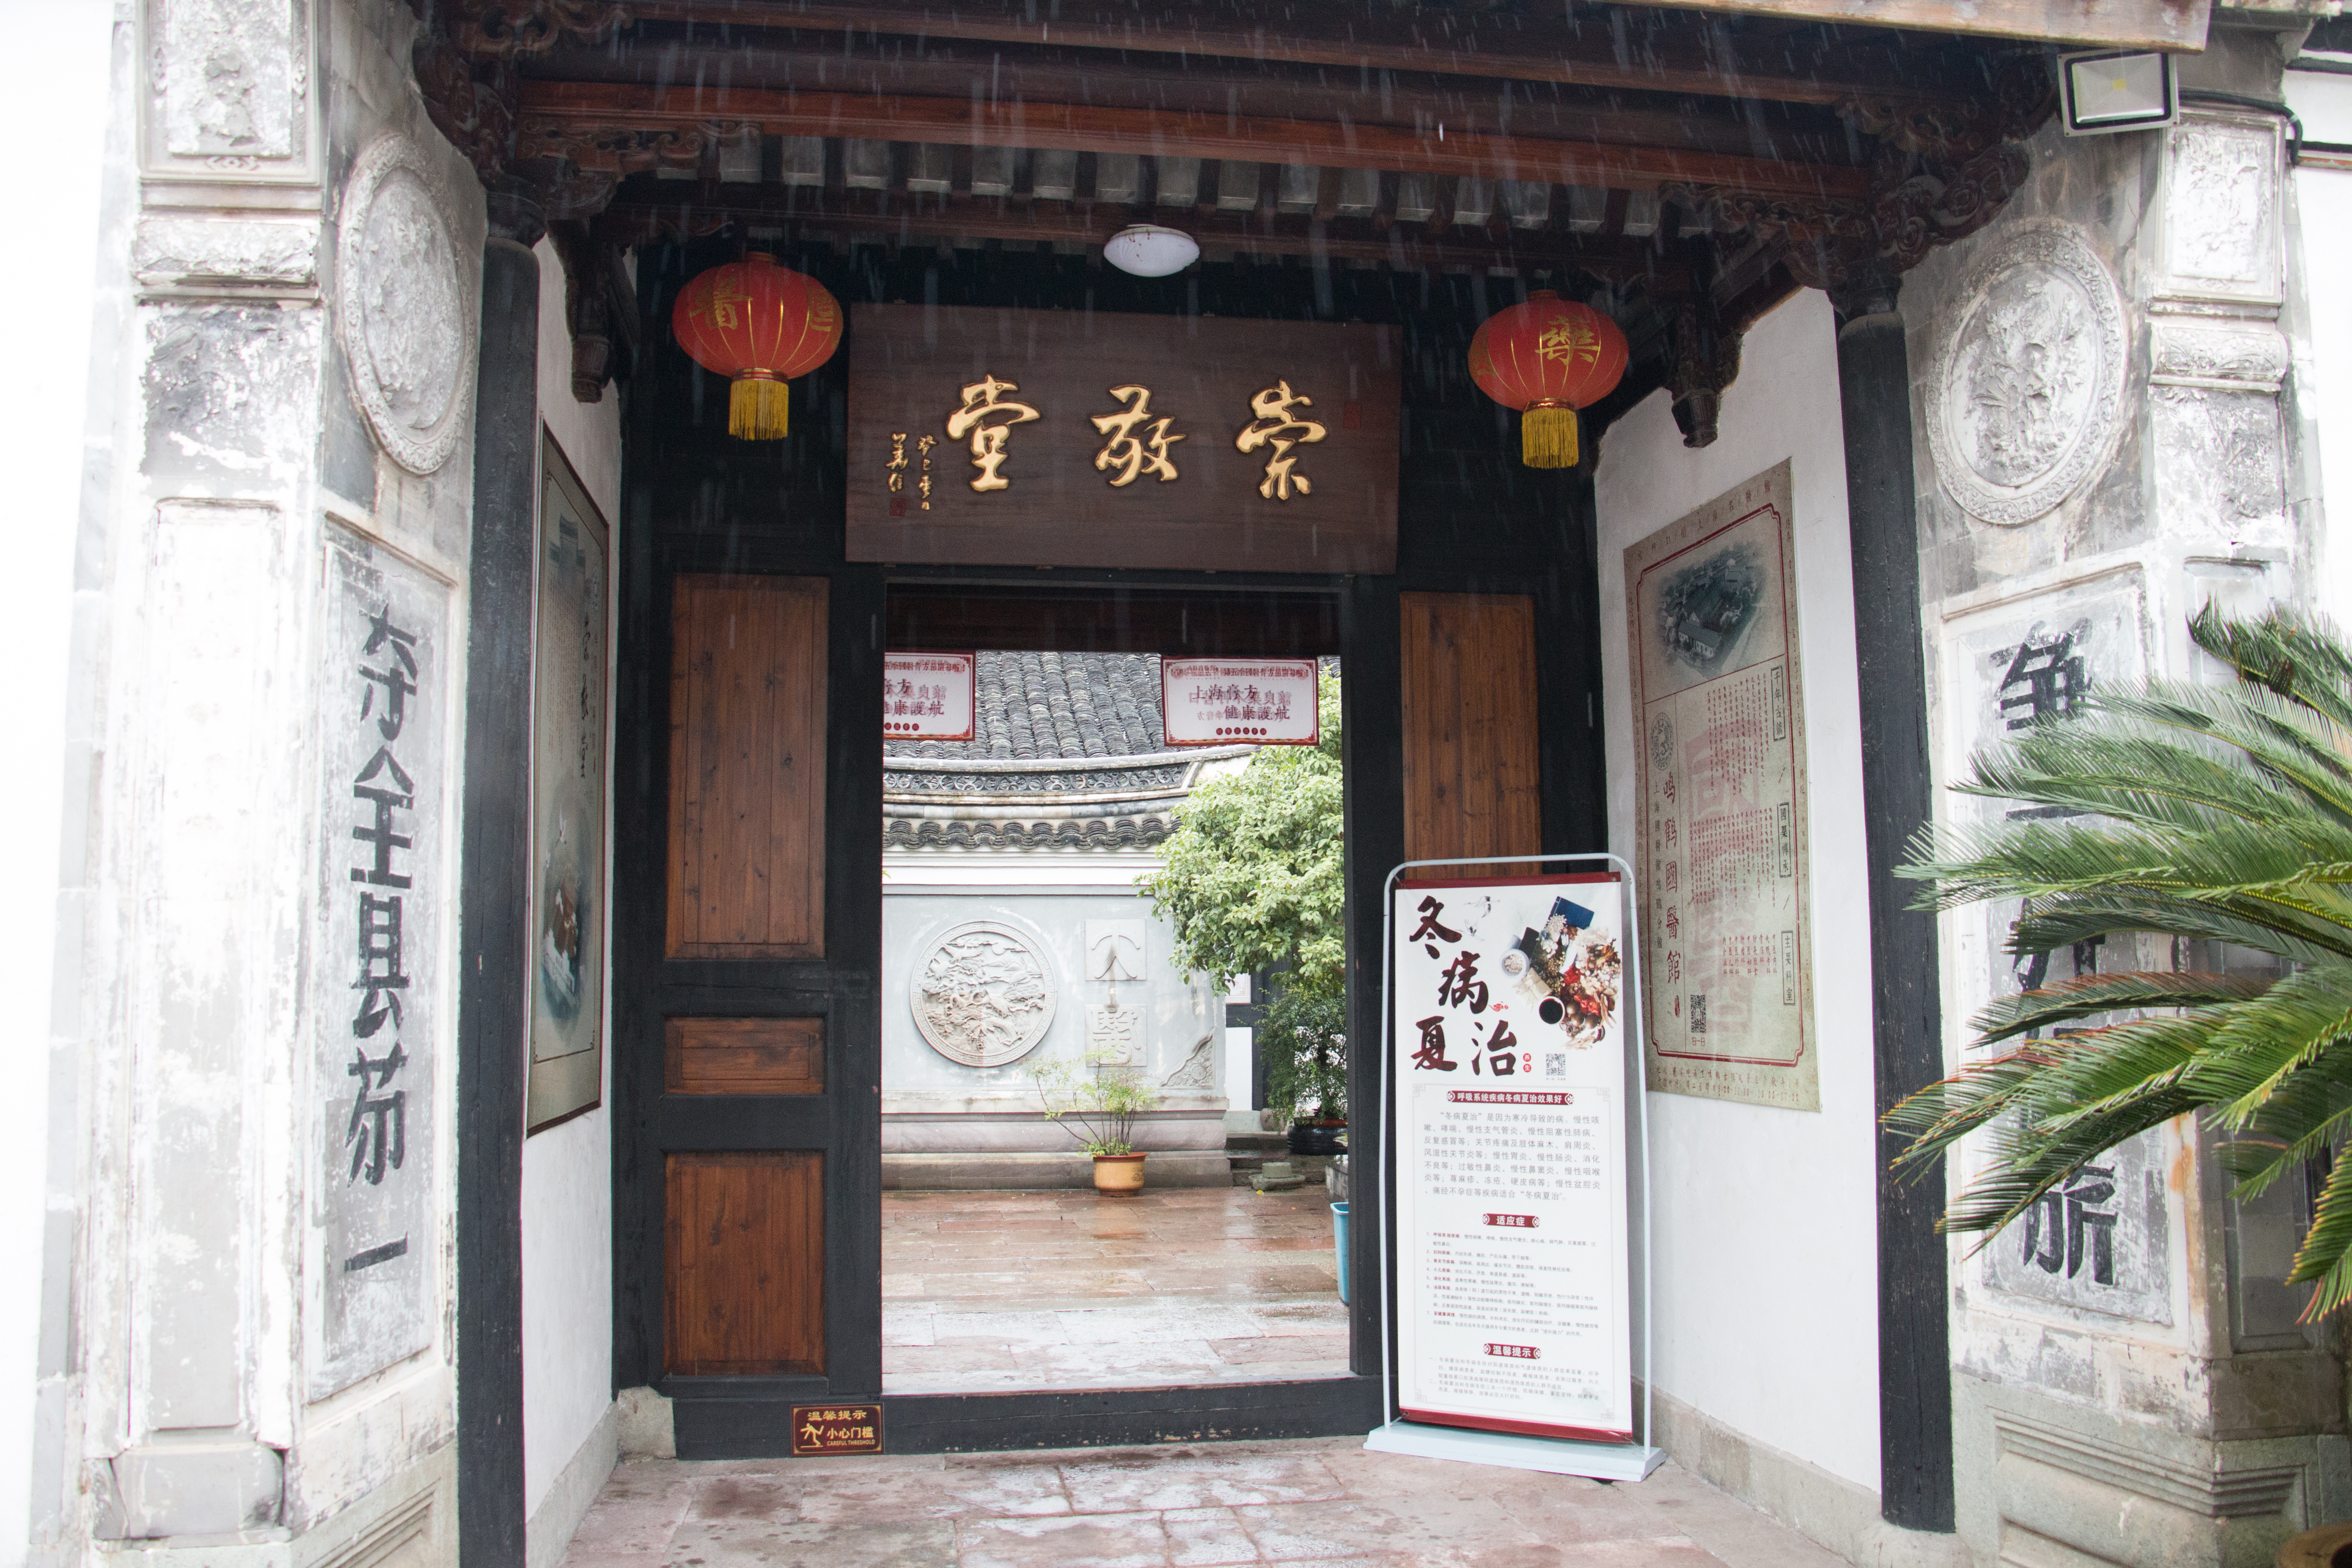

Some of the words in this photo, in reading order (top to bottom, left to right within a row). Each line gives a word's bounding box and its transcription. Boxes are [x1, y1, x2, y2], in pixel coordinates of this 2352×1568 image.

[1783, 935, 1793, 1001] 主要科室
[1457, 1092, 1562, 1104] 呼吸系统疾病冬病夏治效果好
[1496, 1215, 1525, 1226] 适应症
[1492, 1345, 1531, 1357] 温馨提示
[808, 1410, 867, 1421] 温馨提示
[827, 1426, 874, 1439] 小心门槛
